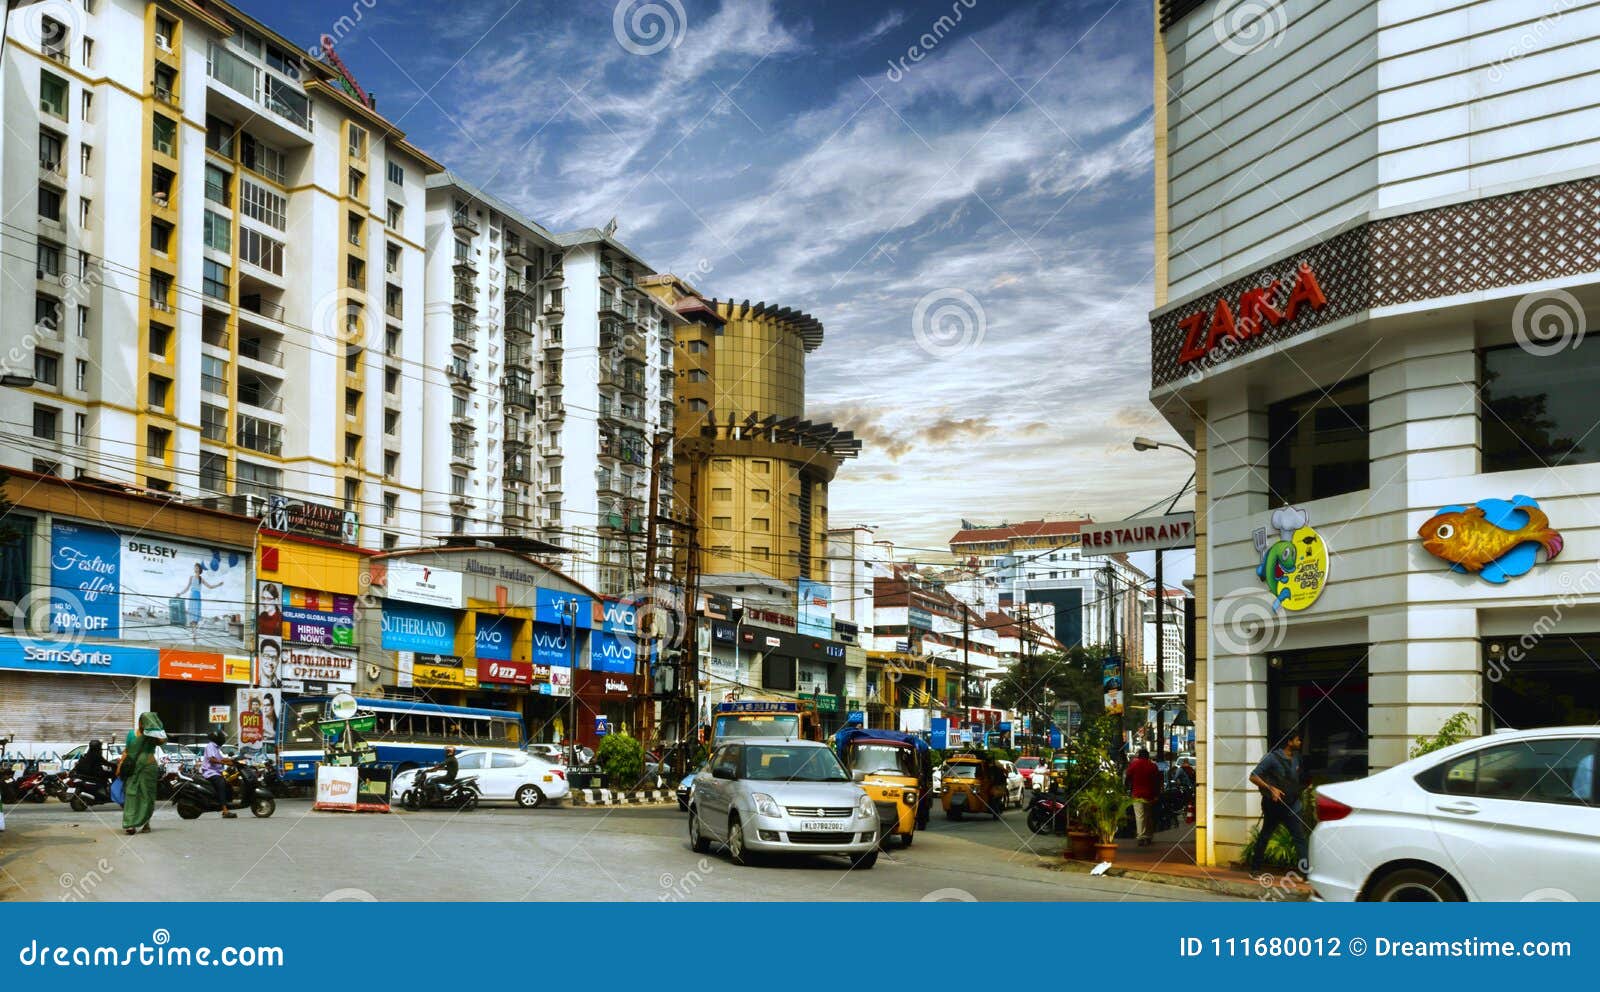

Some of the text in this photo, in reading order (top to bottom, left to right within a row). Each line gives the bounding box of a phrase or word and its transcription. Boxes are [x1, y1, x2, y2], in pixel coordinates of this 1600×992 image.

[1081, 521, 1191, 548] RESTAURANT
[129, 541, 178, 559] DELSEY
[52, 546, 116, 574] Festive
[143, 556, 165, 564] PARIS
[465, 558, 535, 584] Alliance Residency
[79, 577, 116, 602] offer
[53, 612, 109, 630] 40% OFF
[381, 610, 446, 638] SUTHERLAND
[602, 604, 635, 626] vivo
[297, 624, 326, 636] HIRING
[300, 634, 323, 644] NOW!
[475, 627, 502, 643] vivo
[534, 631, 567, 650] vivo
[23, 646, 113, 667] Samsonite
[602, 641, 632, 659] vivo
[294, 668, 341, 679] OPTICALS
[243, 714, 260, 726] DYFI
